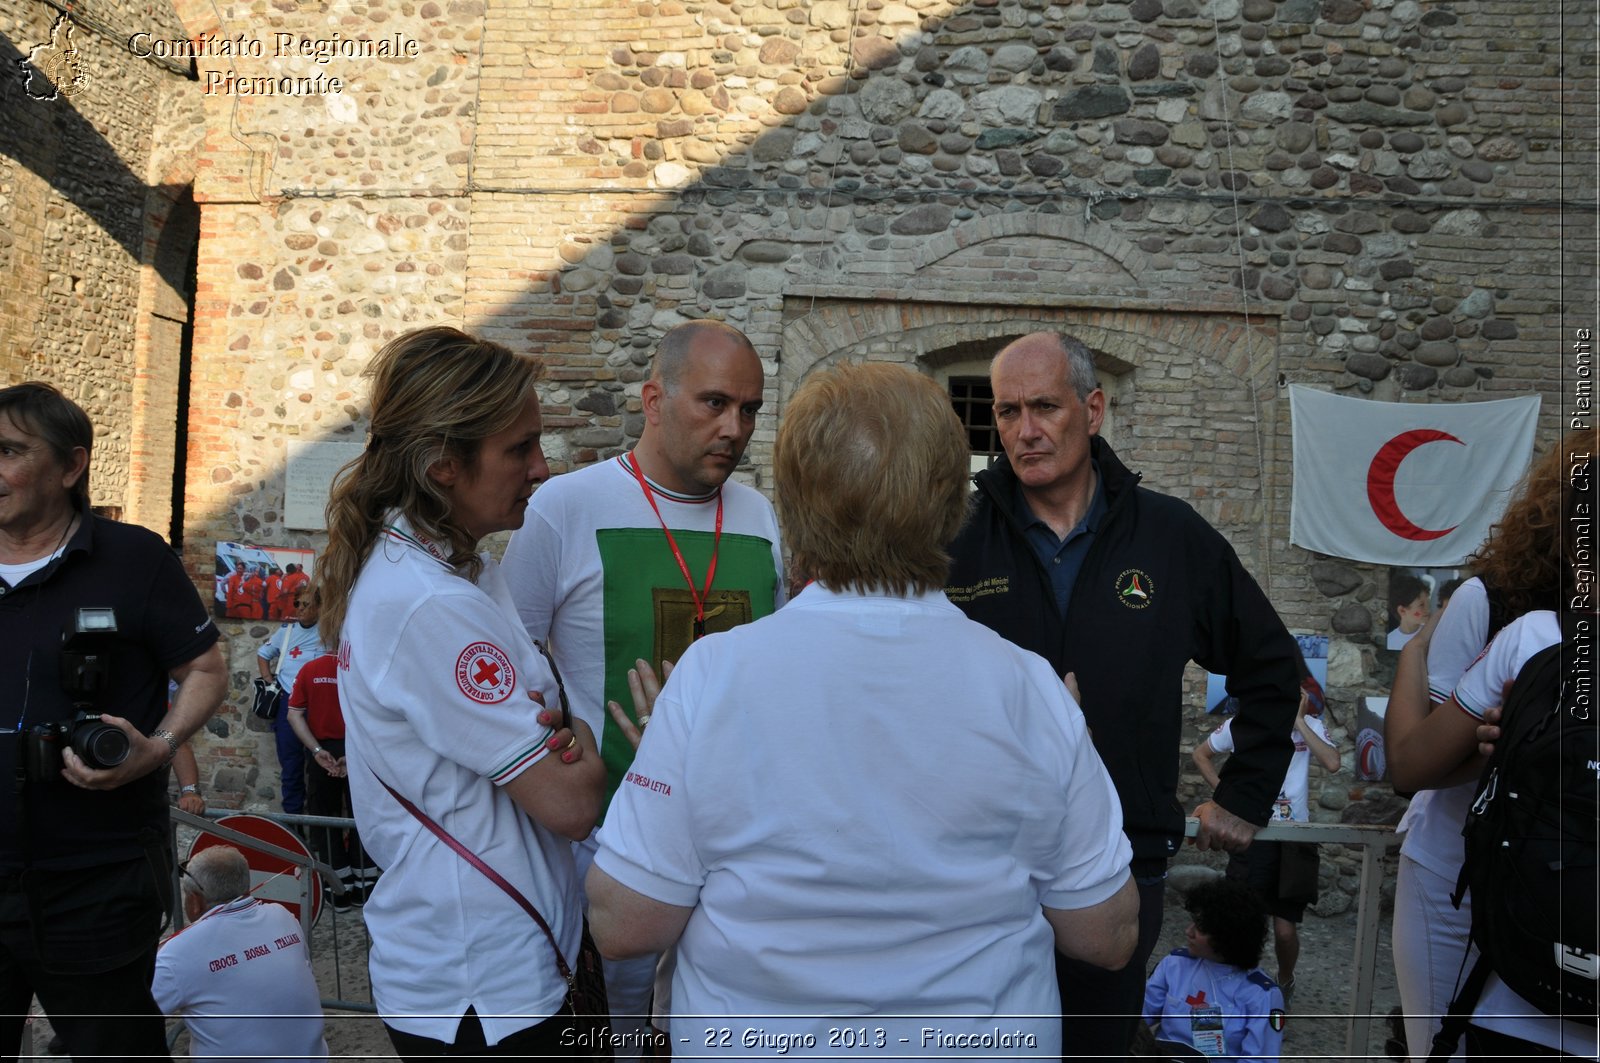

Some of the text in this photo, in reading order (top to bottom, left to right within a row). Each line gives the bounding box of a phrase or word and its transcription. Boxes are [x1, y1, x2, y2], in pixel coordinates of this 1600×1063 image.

[1115, 569, 1144, 589] PROTEZIONE
[1118, 595, 1151, 609] NAZIONALE
[460, 671, 493, 700] CONVENZIONE
[494, 652, 511, 673] AGOSTO
[650, 781, 671, 796] LETTA
[209, 954, 238, 972] CROCE
[243, 945, 271, 960] ROSSA
